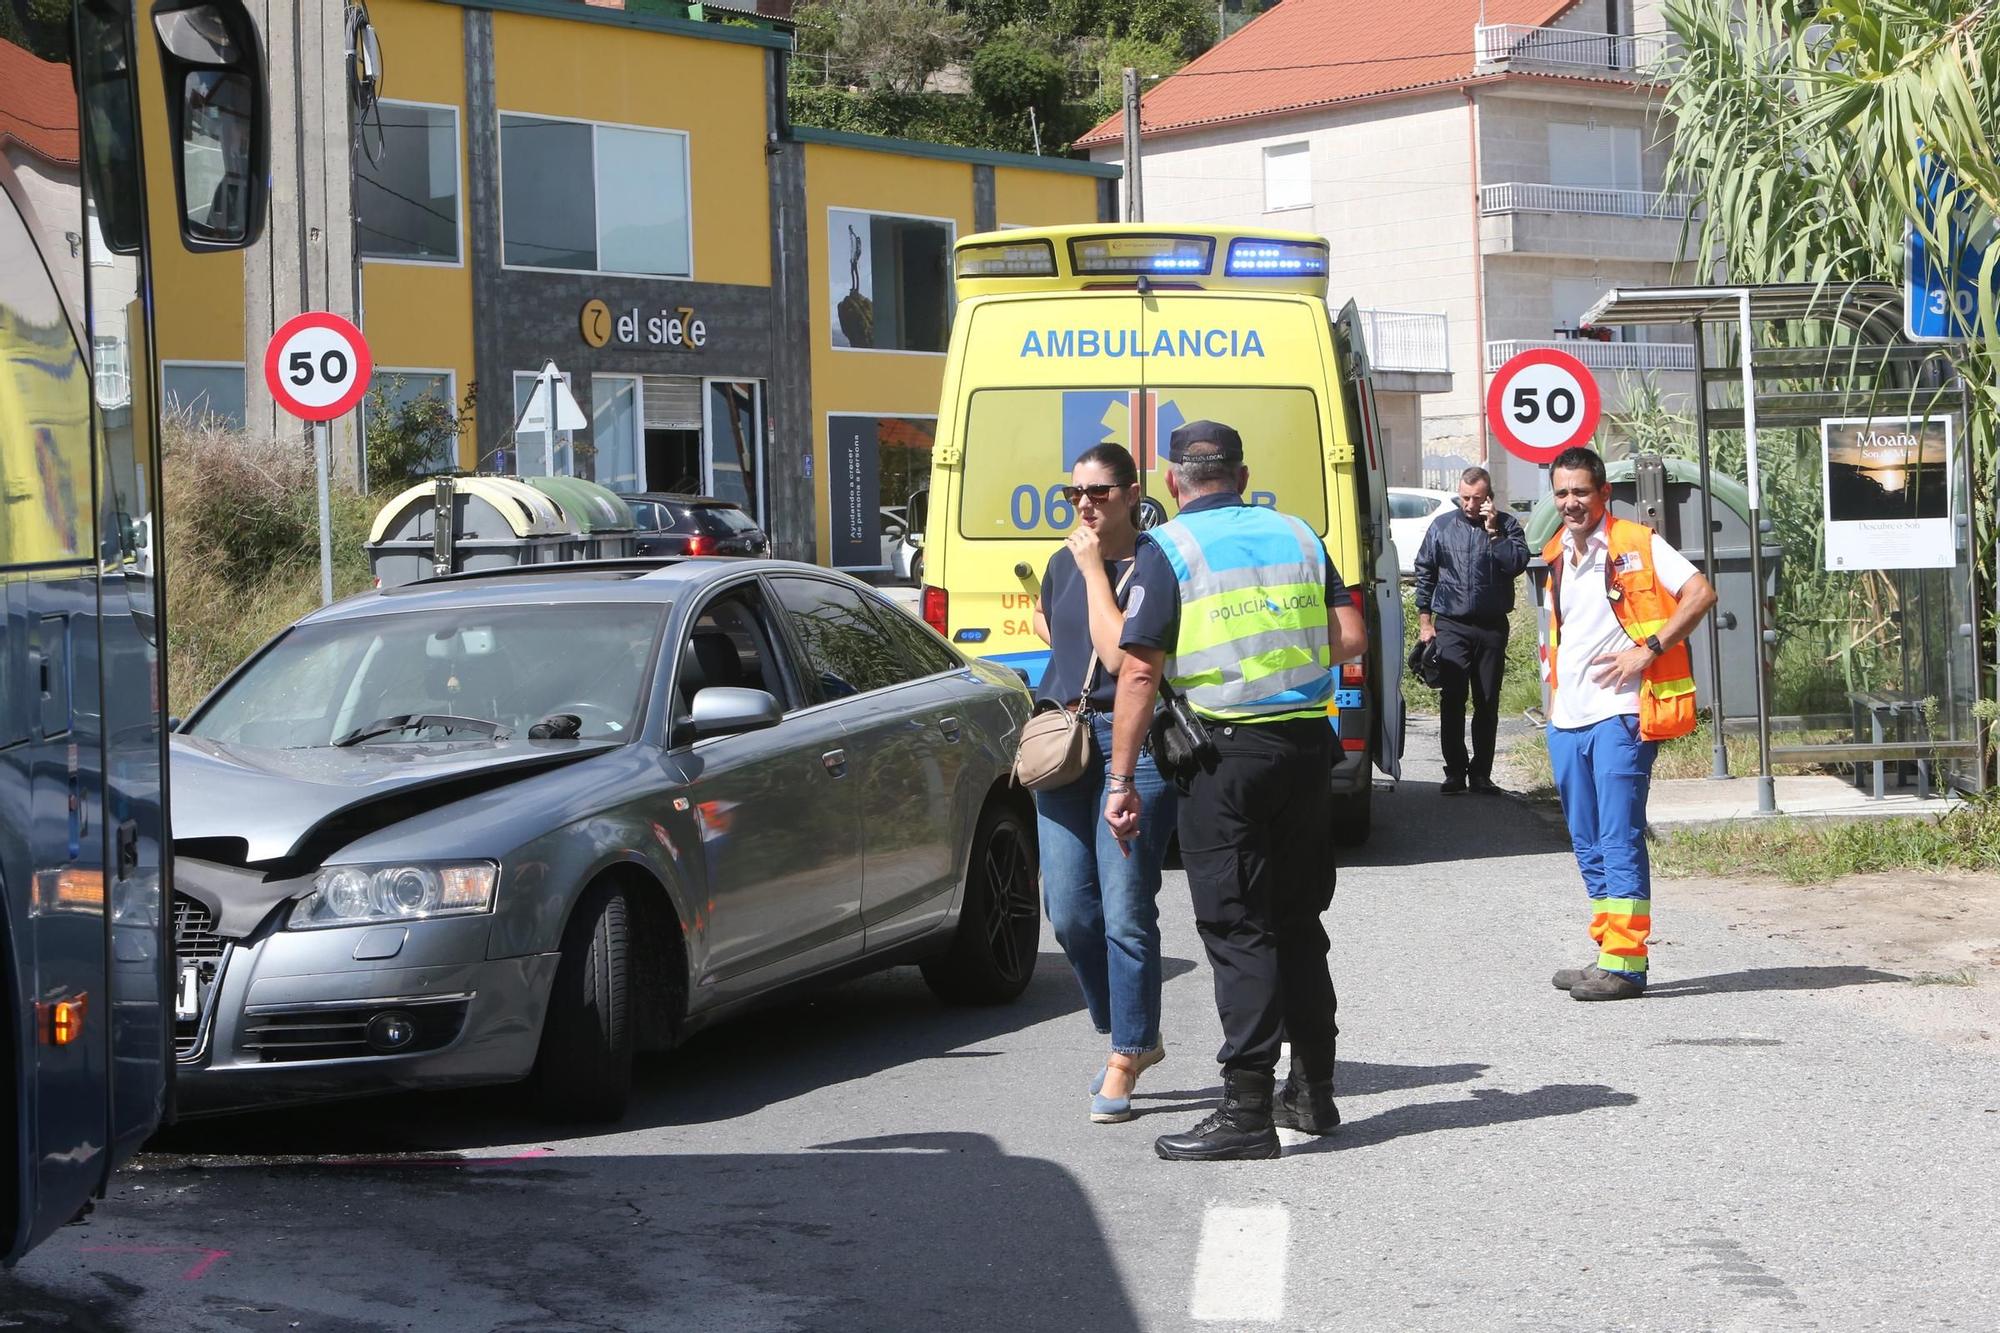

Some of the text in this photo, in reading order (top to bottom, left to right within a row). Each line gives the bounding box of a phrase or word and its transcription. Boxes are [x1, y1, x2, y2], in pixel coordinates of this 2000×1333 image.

[1929, 289, 1998, 315] 30
[617, 307, 640, 343] el
[1019, 329, 1266, 358] AMBULANCIA
[289, 349, 348, 387] 50
[1513, 387, 1576, 424] 50
[1856, 431, 1918, 447] Moaña
[849, 490, 857, 538] Ayudando
[855, 484, 863, 524] persona
[1282, 594, 1320, 610] LOCAL
